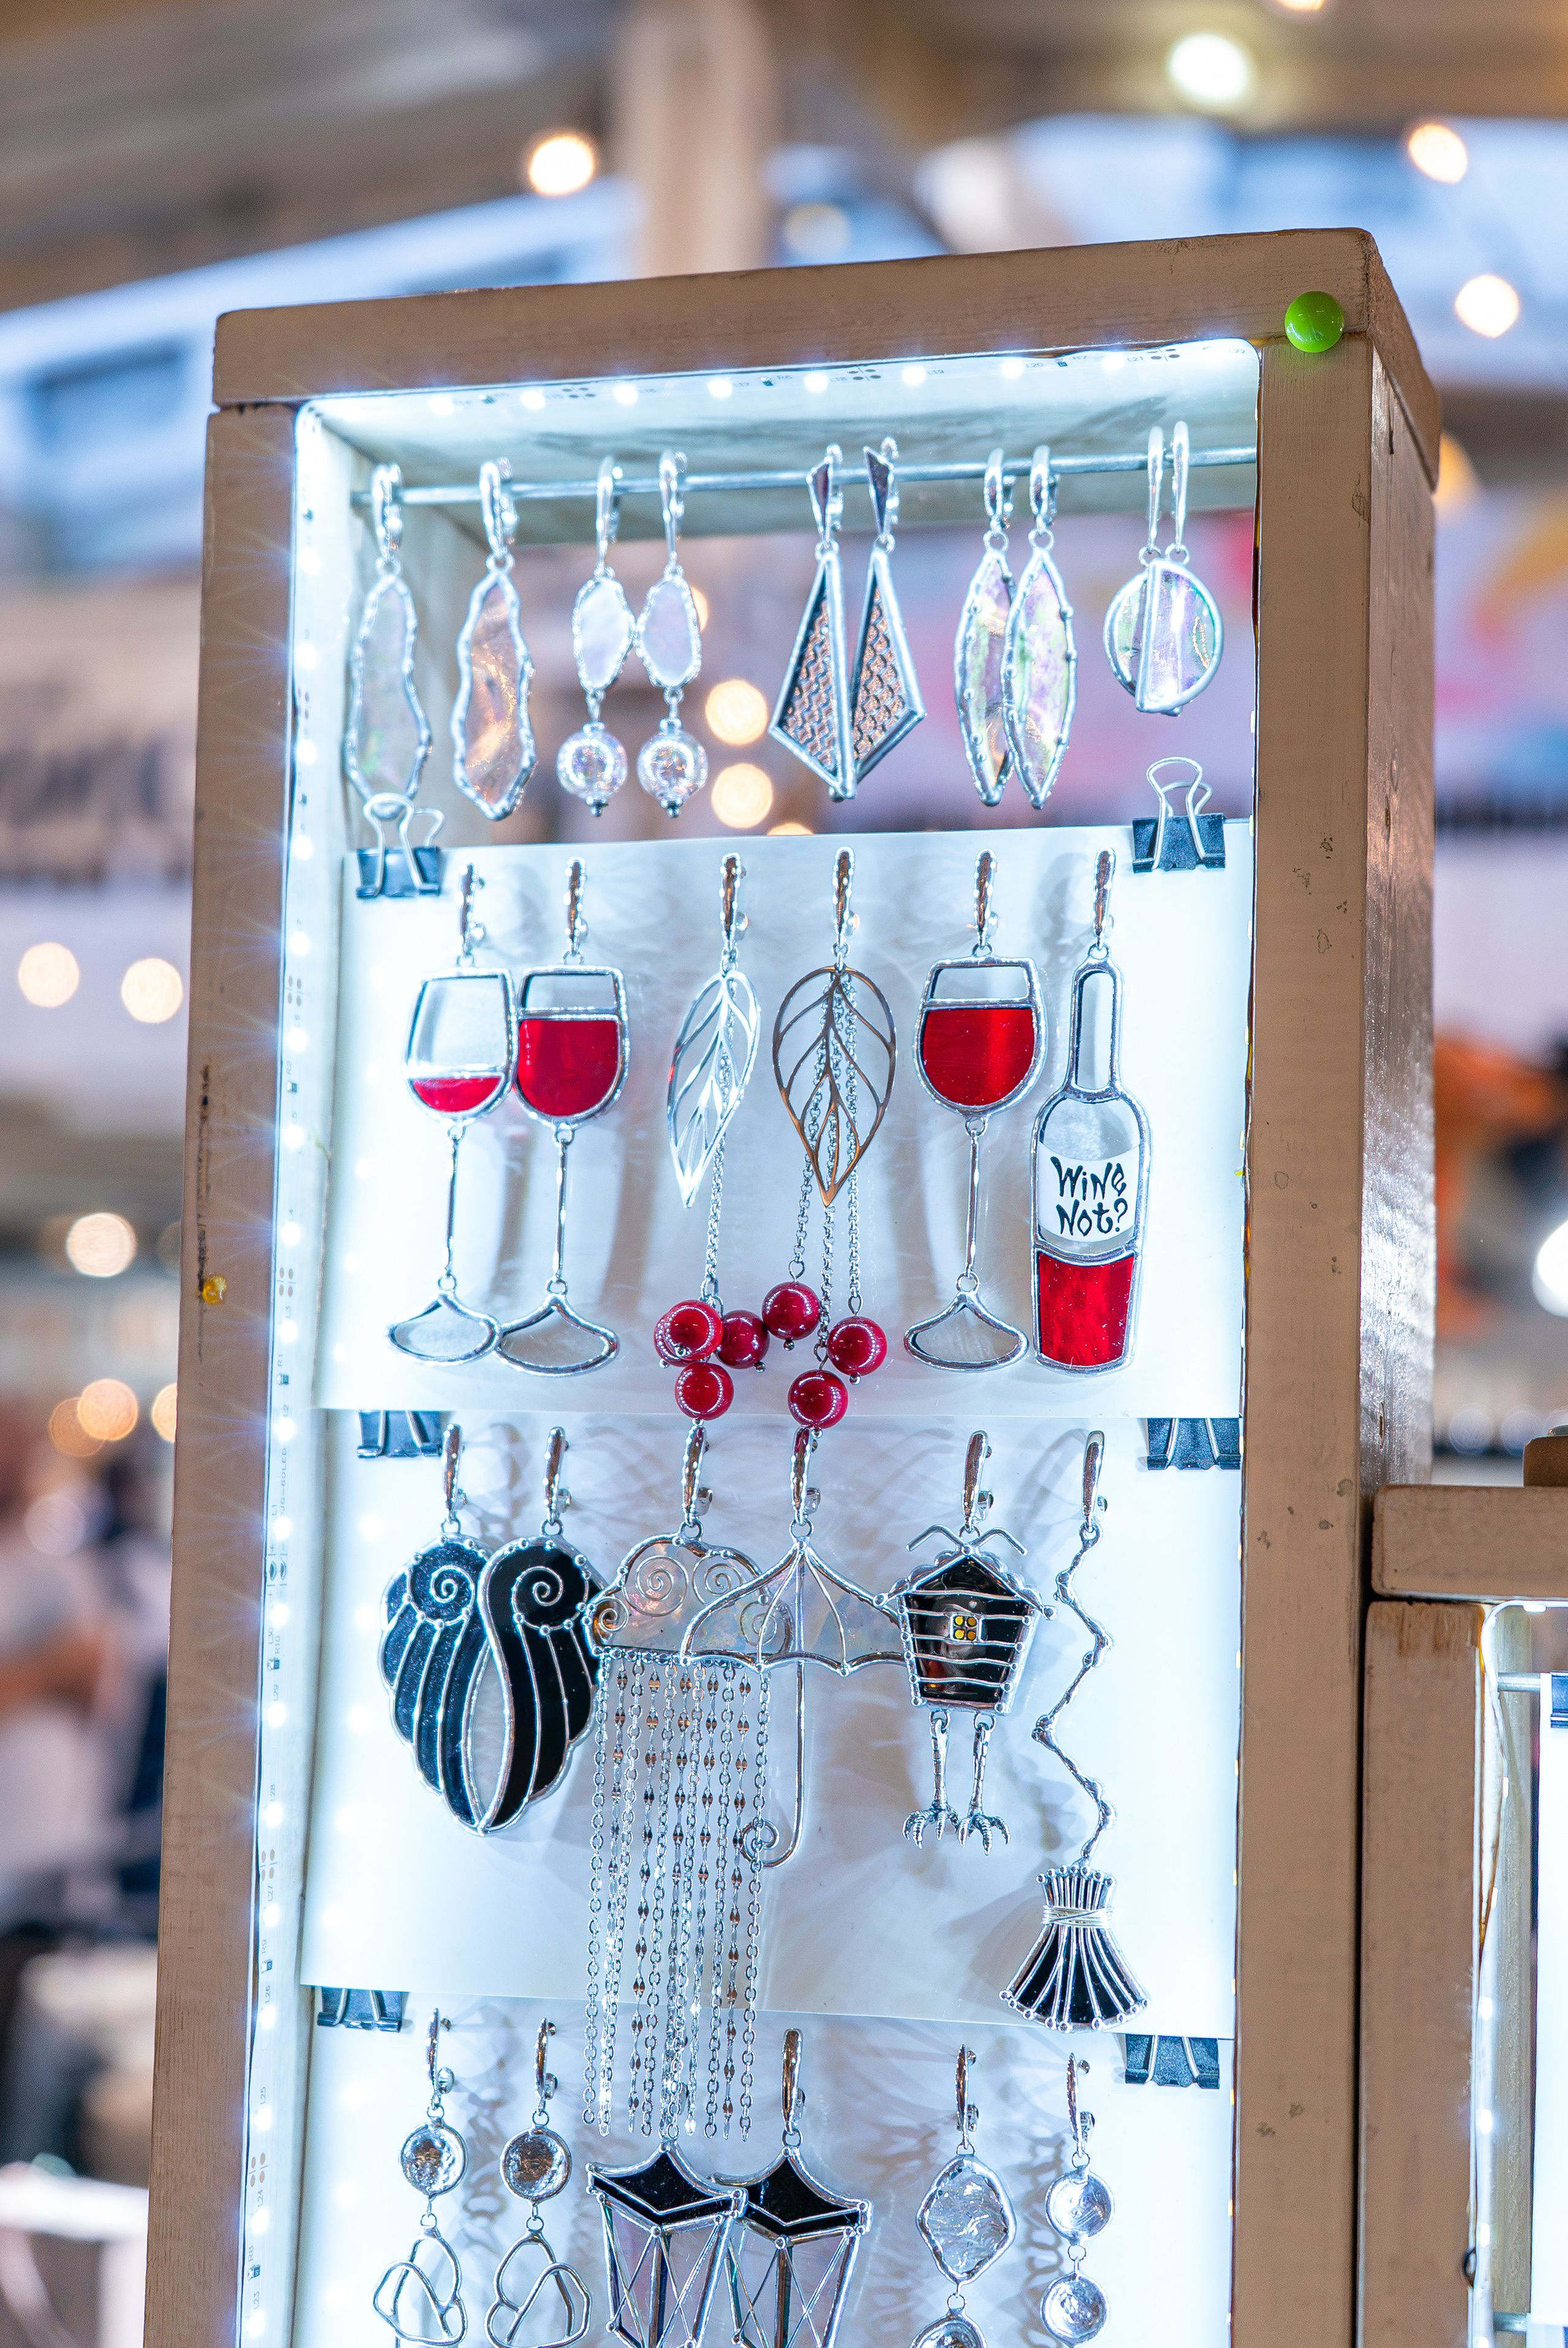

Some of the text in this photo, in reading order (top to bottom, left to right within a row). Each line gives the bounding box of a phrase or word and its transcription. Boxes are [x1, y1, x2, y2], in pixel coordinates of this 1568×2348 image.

[285, 1061, 292, 1076] R2
[285, 1305, 292, 1319] L3
[277, 1353, 284, 1367] R1
[282, 1403, 289, 1417] L2
[271, 1504, 278, 1516] L1
[261, 1938, 268, 1954] R9
[247, 2245, 255, 2263] R8
